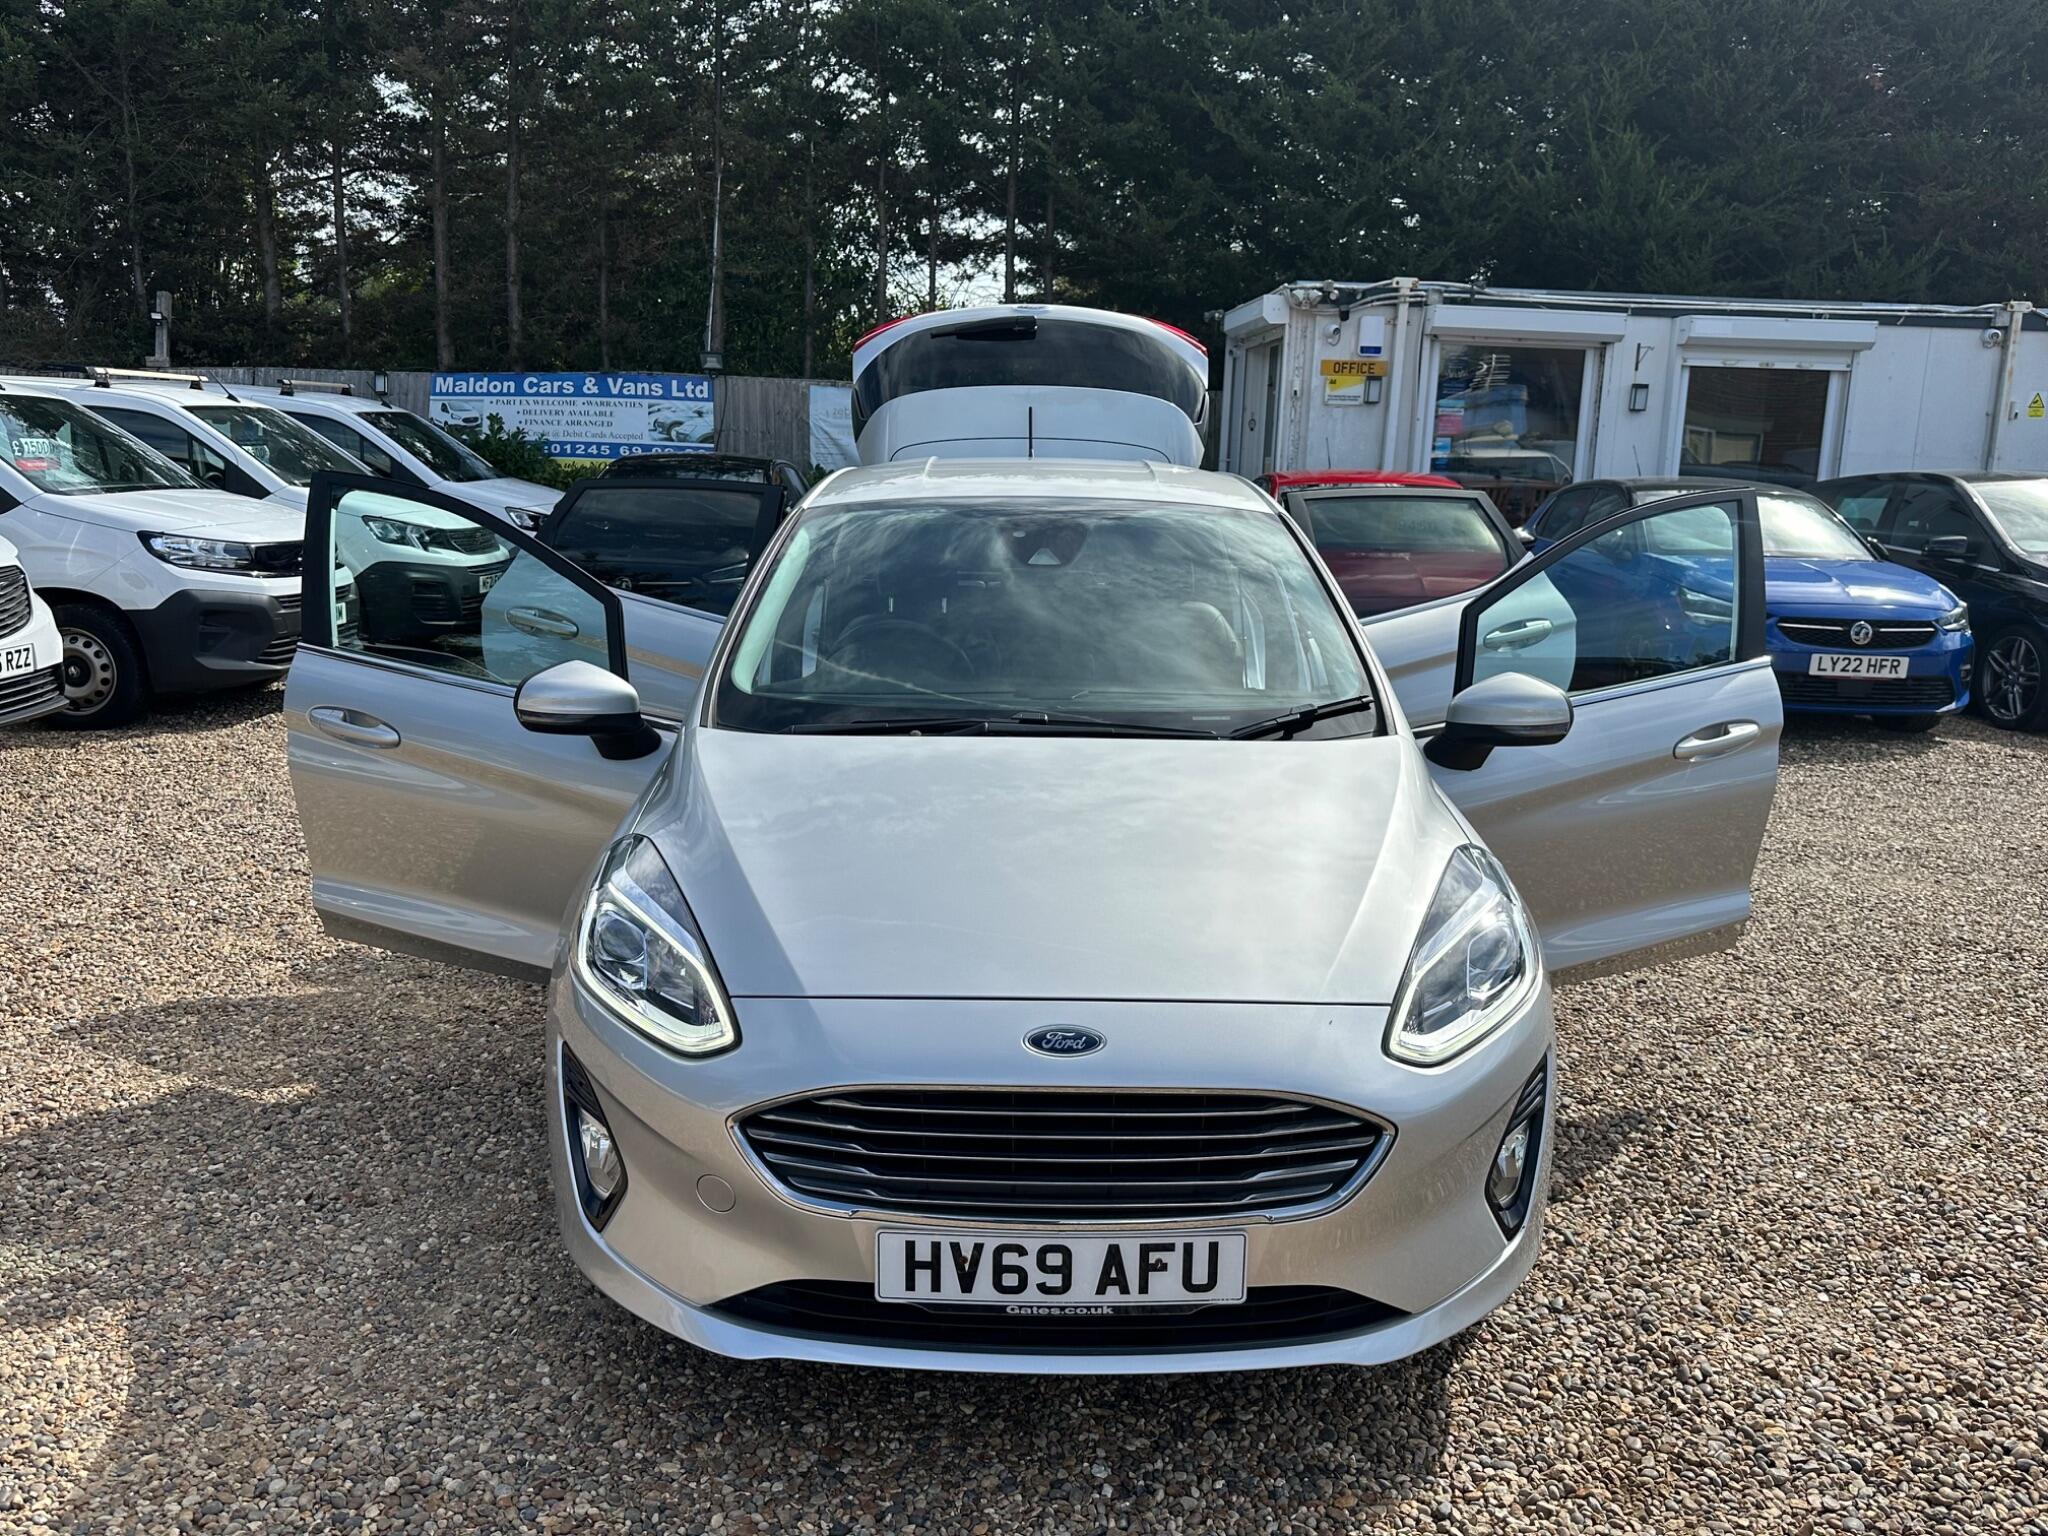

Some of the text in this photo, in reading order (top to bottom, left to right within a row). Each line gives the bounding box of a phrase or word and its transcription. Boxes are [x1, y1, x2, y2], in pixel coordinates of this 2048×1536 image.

[1333, 362, 1376, 374] OFFICE
[435, 376, 709, 398] Maldon Cars & Vans Ltd
[586, 400, 644, 408] WARRANTIES
[568, 409, 615, 417] AVAILABLE
[524, 418, 613, 427] FINANCE ARRANGED
[562, 430, 583, 438] Debit
[584, 431, 606, 439] Cards
[608, 432, 644, 440] Accepted
[5, 647, 31, 672] RZZ
[1817, 656, 1901, 675] LY22 HFR
[1041, 1031, 1087, 1049] Ford
[904, 1240, 1220, 1295] HV69 AFU
[1006, 1304, 1114, 1316] Gates.co.uk
